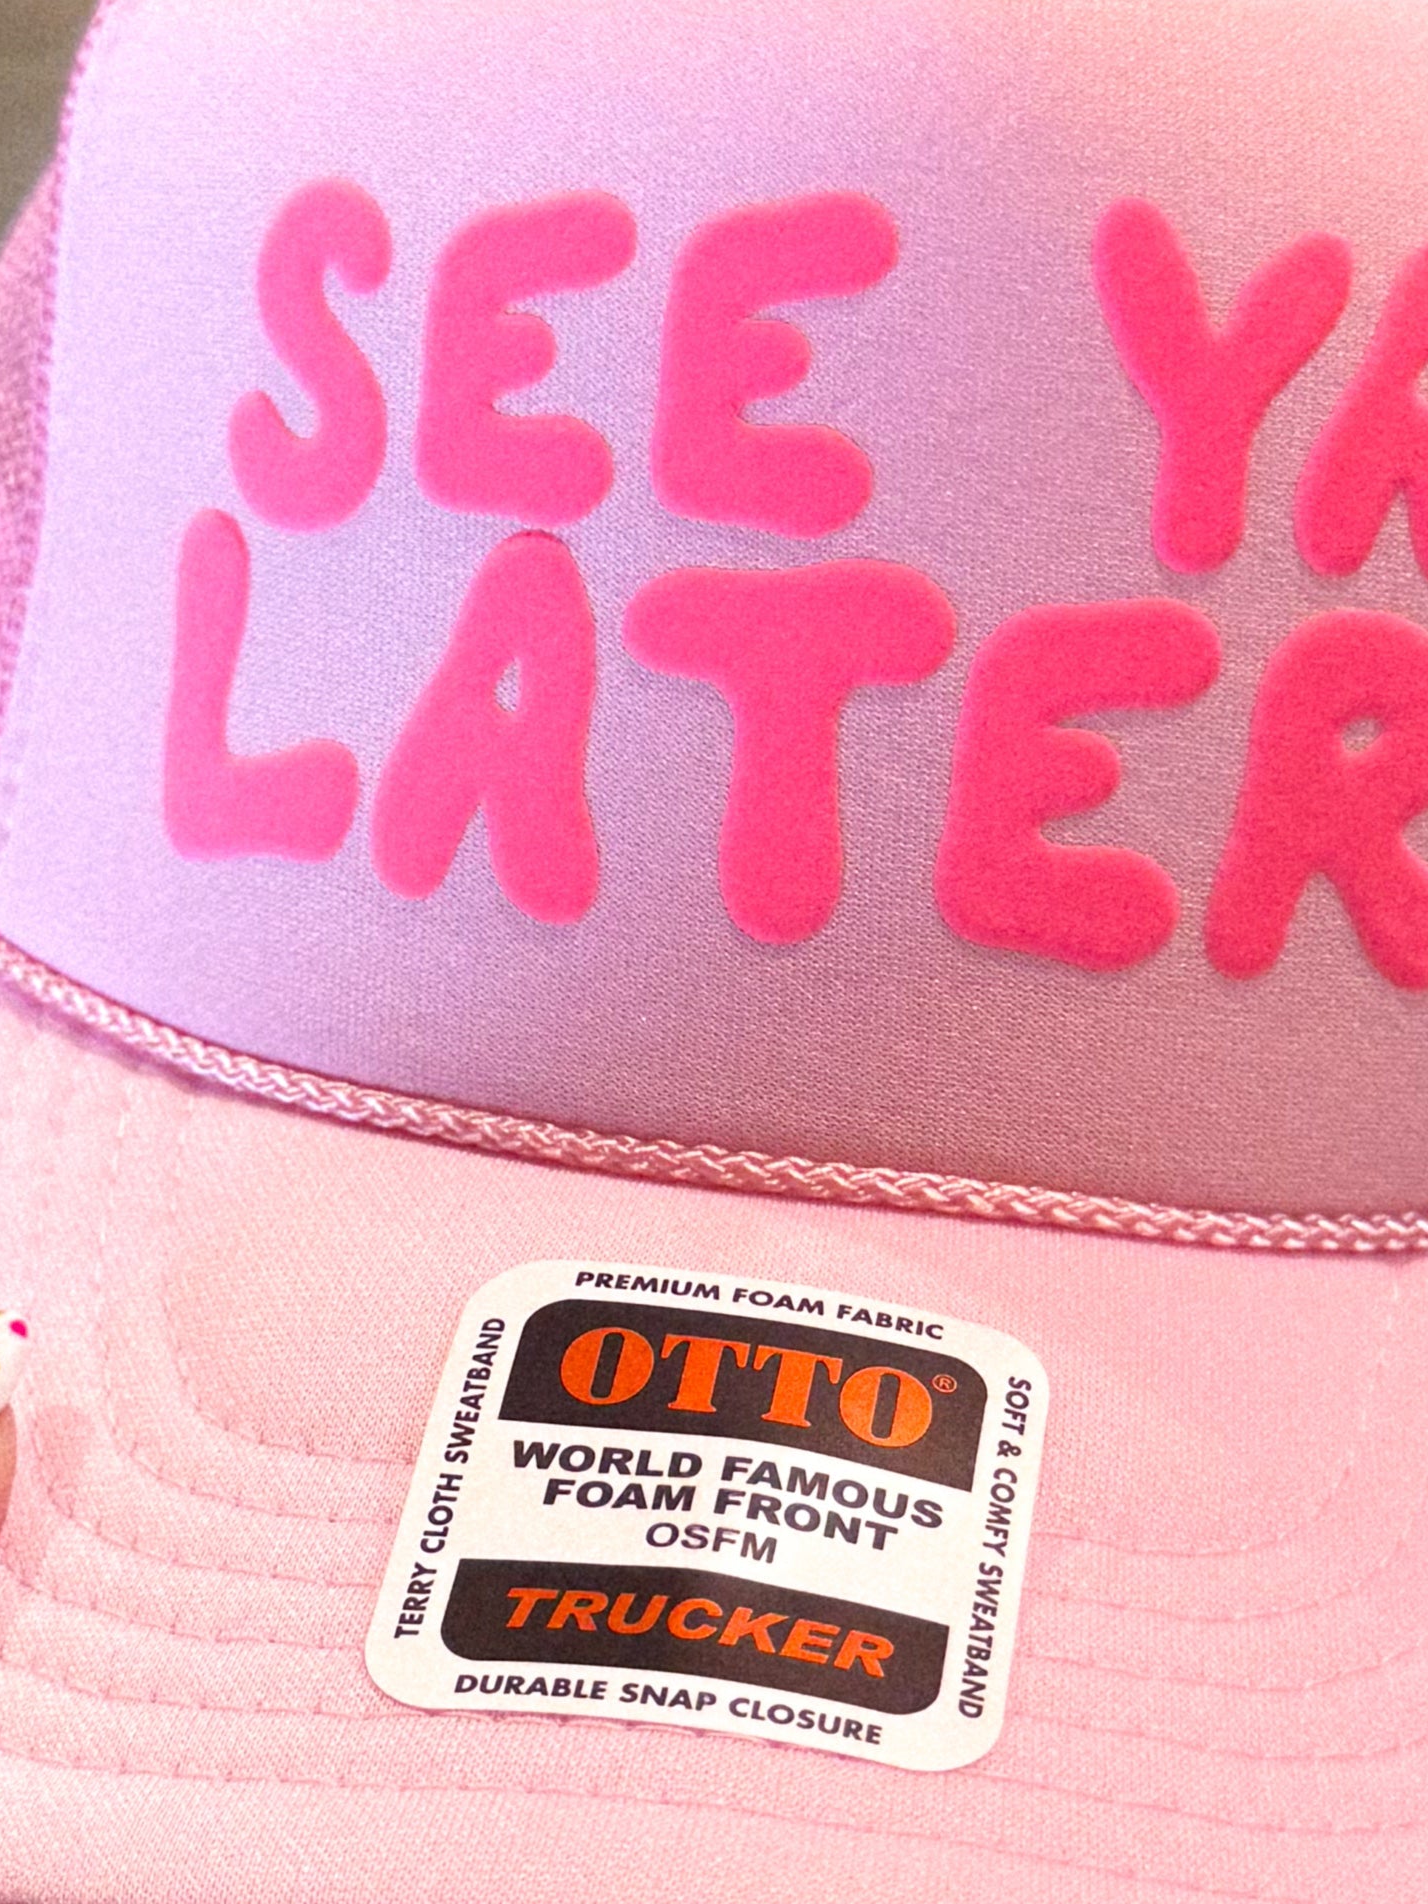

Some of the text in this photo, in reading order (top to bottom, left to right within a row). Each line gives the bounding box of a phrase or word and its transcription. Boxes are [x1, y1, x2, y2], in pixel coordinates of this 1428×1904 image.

[227, 177, 900, 540] SEE
[575, 1271, 944, 1340] PREMIUM FOAM FABRIC
[394, 1318, 506, 1639] TERRY CLOTH SWEATBAND
[513, 1439, 943, 1529] WORLD FAMOUS
[542, 1478, 899, 1551] FOAM FRONT
[645, 1522, 778, 1564] OSFM
[958, 1376, 1032, 1719] SOFT & COMFY SWEATBAND
[505, 1587, 895, 1678] TRUCKER
[454, 1674, 883, 1746] DURABLE SNAP CLOSURE
